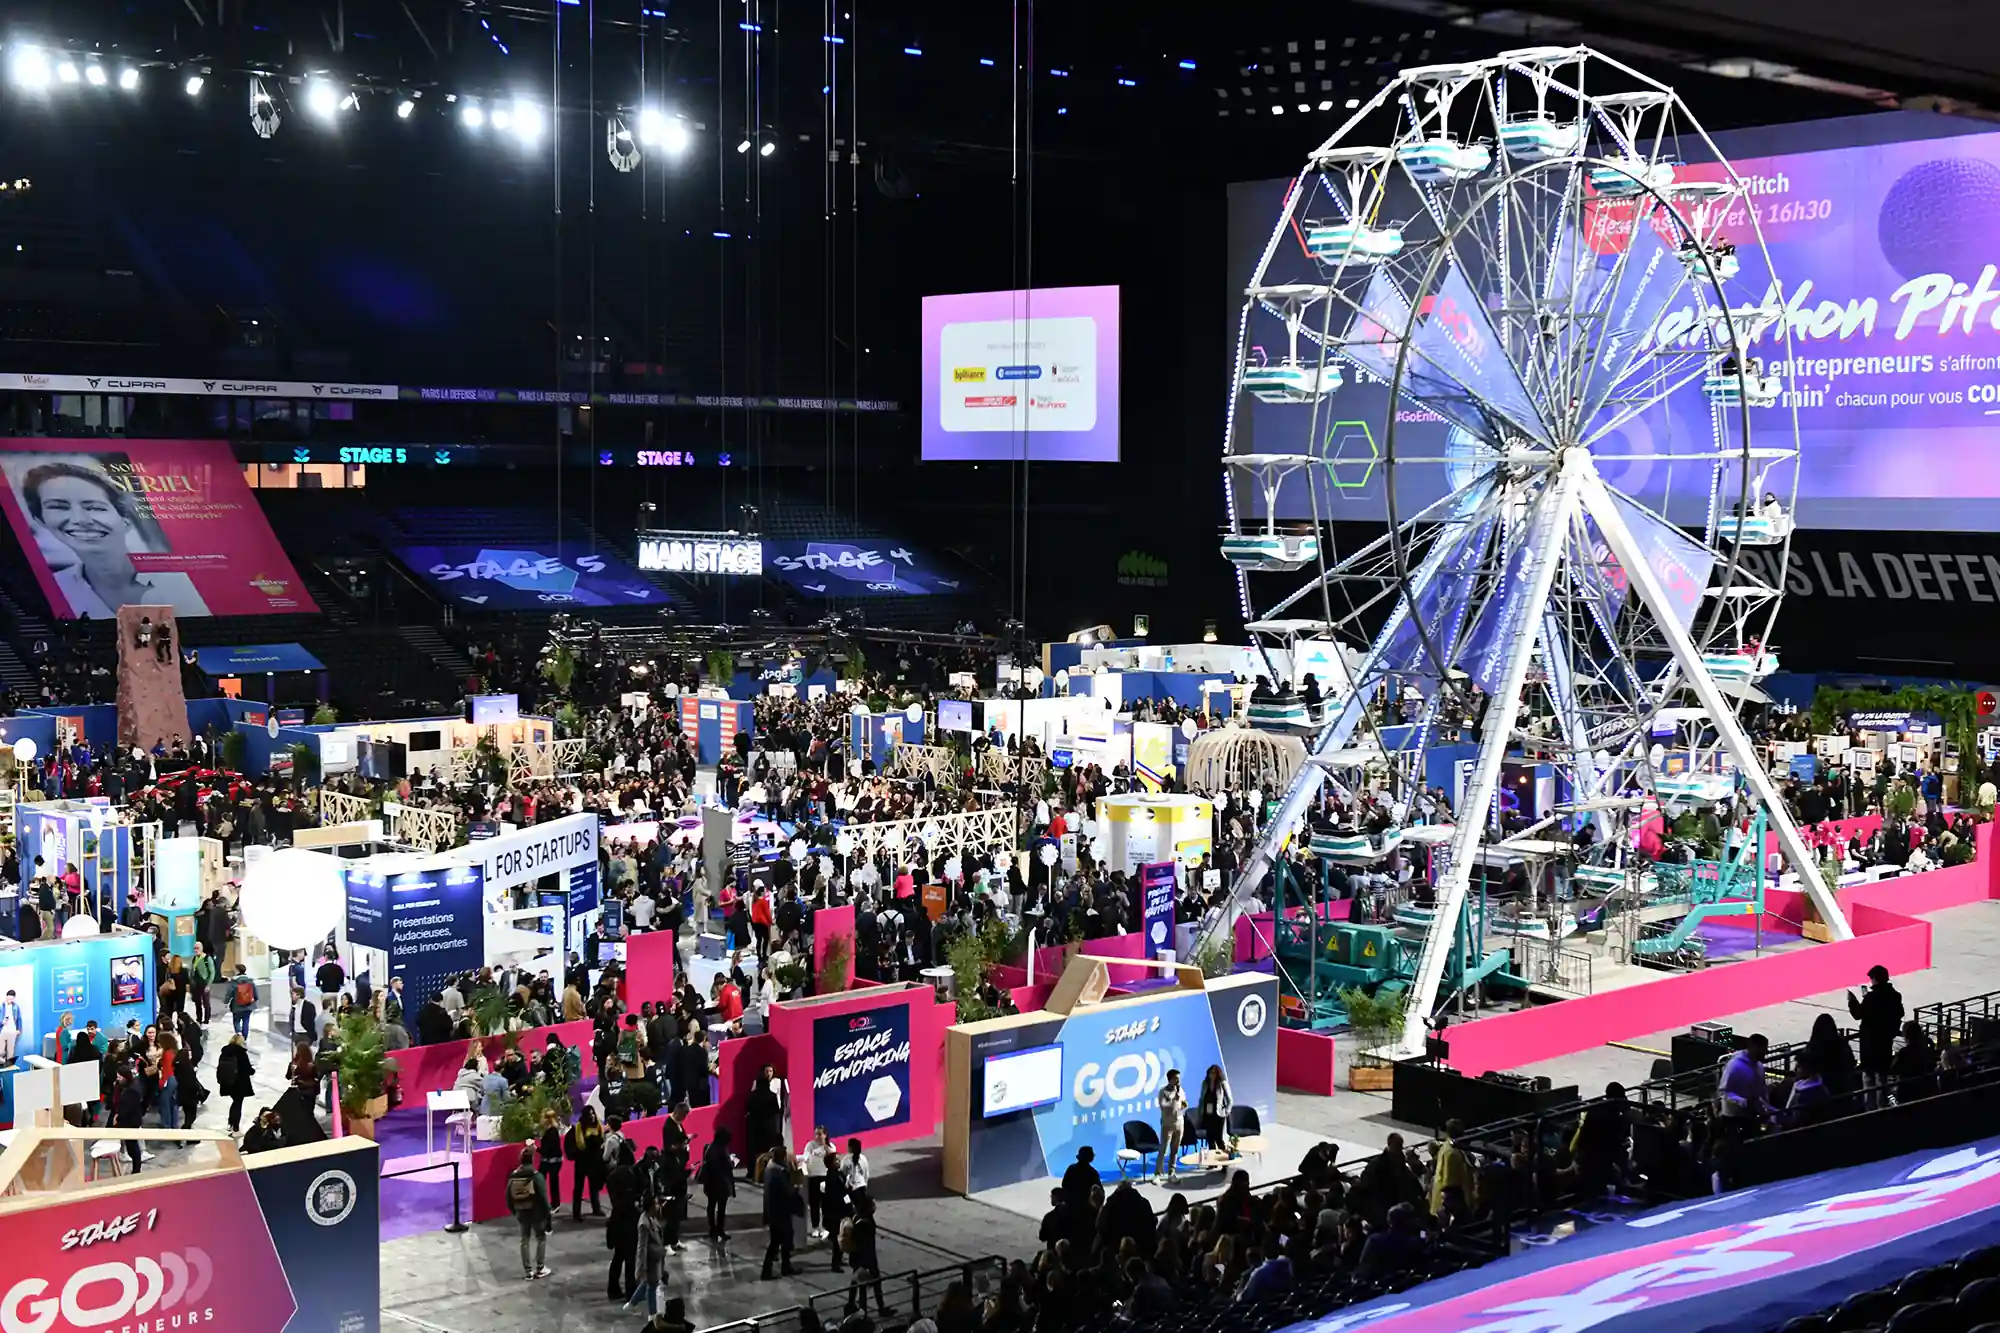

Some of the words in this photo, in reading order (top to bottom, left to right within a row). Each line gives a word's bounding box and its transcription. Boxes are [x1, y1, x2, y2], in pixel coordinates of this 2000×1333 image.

[1768, 199, 1831, 223] 16h30
[1769, 353, 1933, 381] entrepreneurs
[108, 380, 166, 389] CUPRA
[222, 384, 277, 392] CUPRA
[330, 387, 382, 396] CUPRA
[1836, 391, 1887, 408] chacun
[1891, 391, 1925, 409] pour
[1929, 390, 1963, 404] vous
[340, 447, 392, 463] STAGE
[396, 448, 407, 463] 5
[637, 451, 681, 466] STAGE
[684, 452, 695, 465] 4
[429, 556, 560, 580] STAGE
[576, 555, 606, 573] 5
[639, 541, 692, 570] MAIN
[694, 542, 762, 574] STAGE
[773, 550, 884, 571] STAGE
[890, 547, 914, 566] 4
[1810, 551, 1876, 598] LA
[496, 850, 522, 878] FOR
[525, 829, 590, 868] STARTUPS
[393, 913, 454, 928] Présentations
[393, 928, 452, 942] Audacieuses,
[394, 944, 418, 955] Idées
[420, 938, 468, 953] Innovantes
[1104, 1018, 1148, 1044] STAGE
[1150, 1015, 1160, 1033] 2
[834, 1028, 892, 1063] ESPACE
[813, 1041, 910, 1089] NETWORKING
[61, 1209, 138, 1251] STAGE
[146, 1208, 157, 1231] 1
